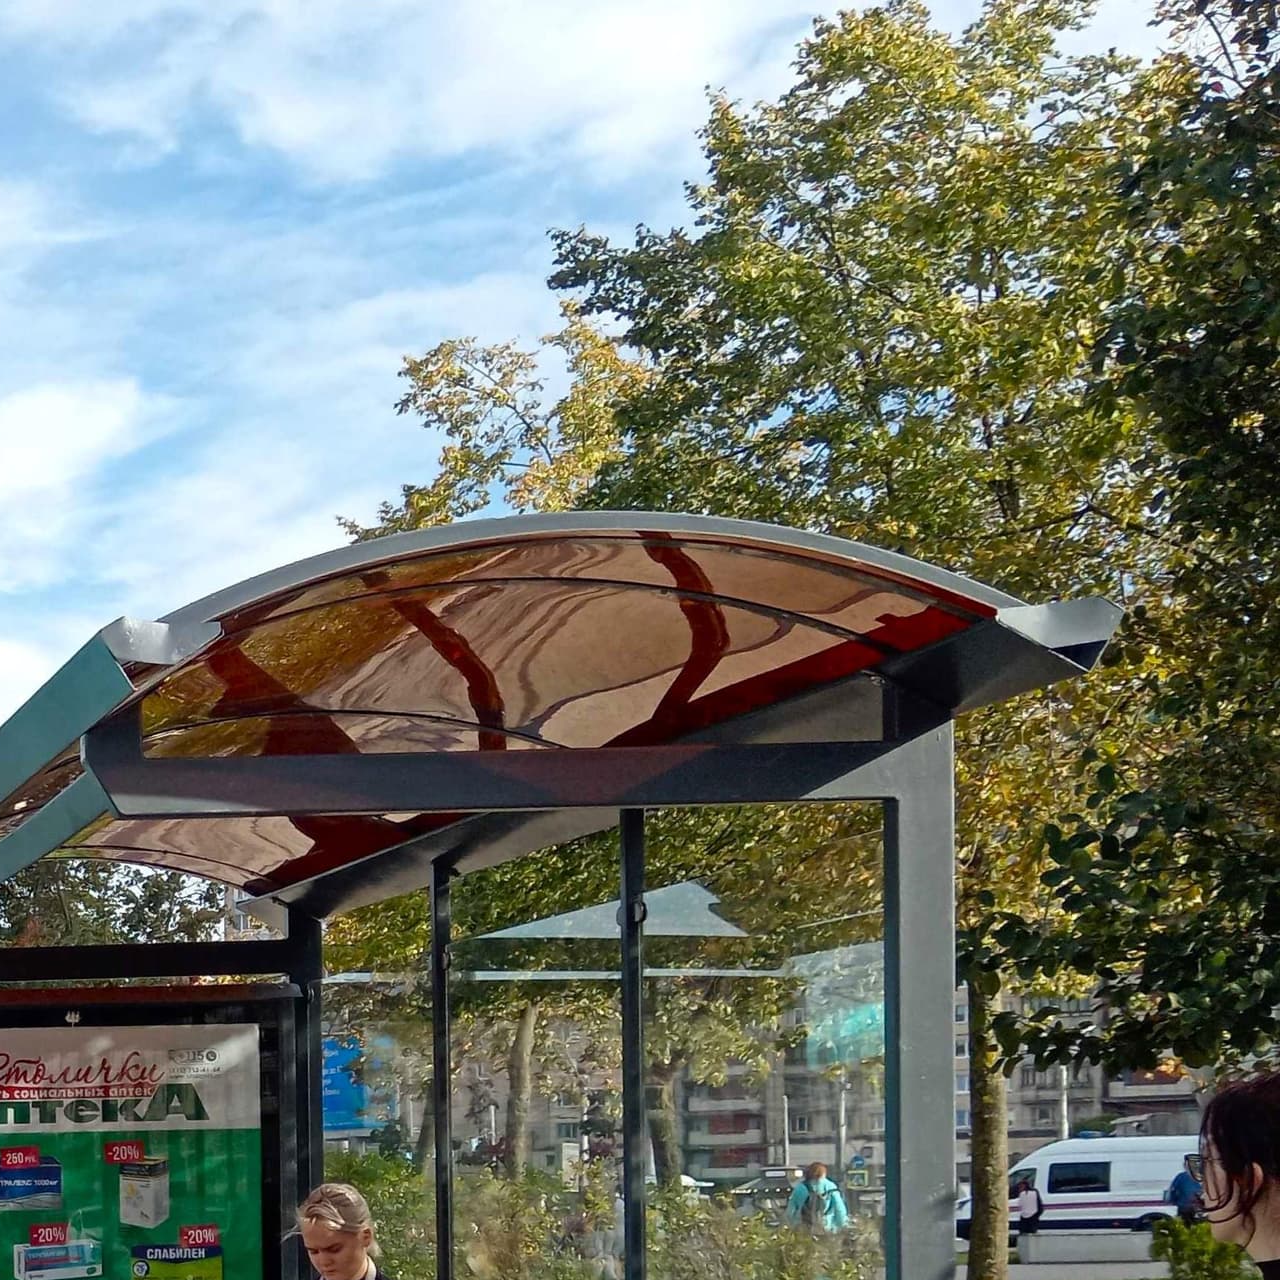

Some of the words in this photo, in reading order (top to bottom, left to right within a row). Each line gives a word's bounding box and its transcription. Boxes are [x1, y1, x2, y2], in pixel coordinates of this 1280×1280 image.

[13, 1088, 105, 1101] социальных
[109, 1086, 153, 1097] аптек
[107, 1146, 140, 1161] -20%
[32, 1227, 65, 1243] -20%
[183, 1229, 215, 1244] -20%
[146, 1247, 206, 1260] СЛАБИЛЕН
